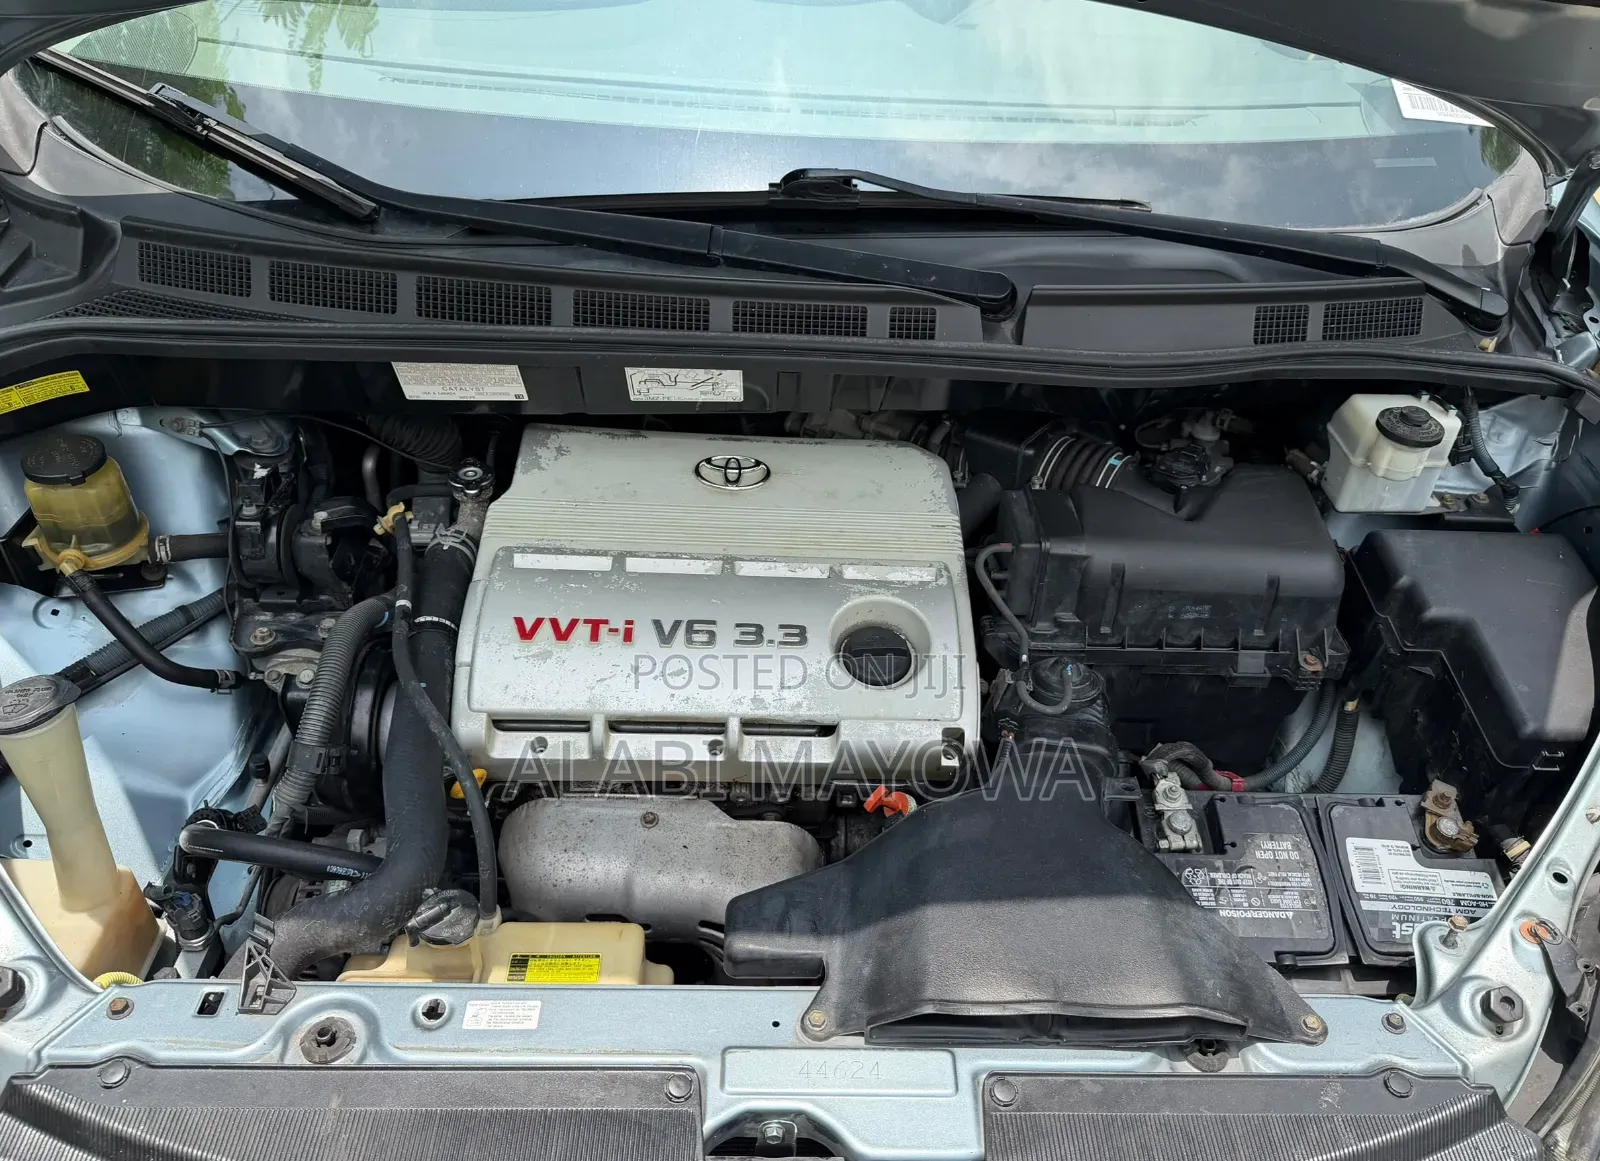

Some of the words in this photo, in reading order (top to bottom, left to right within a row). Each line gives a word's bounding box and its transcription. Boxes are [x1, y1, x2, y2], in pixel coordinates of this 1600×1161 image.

[513, 617, 634, 645] VVT-i
[651, 619, 718, 648] V6
[733, 623, 809, 649] 3.3
[1260, 841, 1292, 849] BATTERY!
[1255, 850, 1273, 859] OPEN
[1275, 851, 1288, 859] NOT
[1289, 851, 1299, 859] DO
[1391, 905, 1452, 913] TECHNOLOGY
[797, 1059, 884, 1081] 44624
